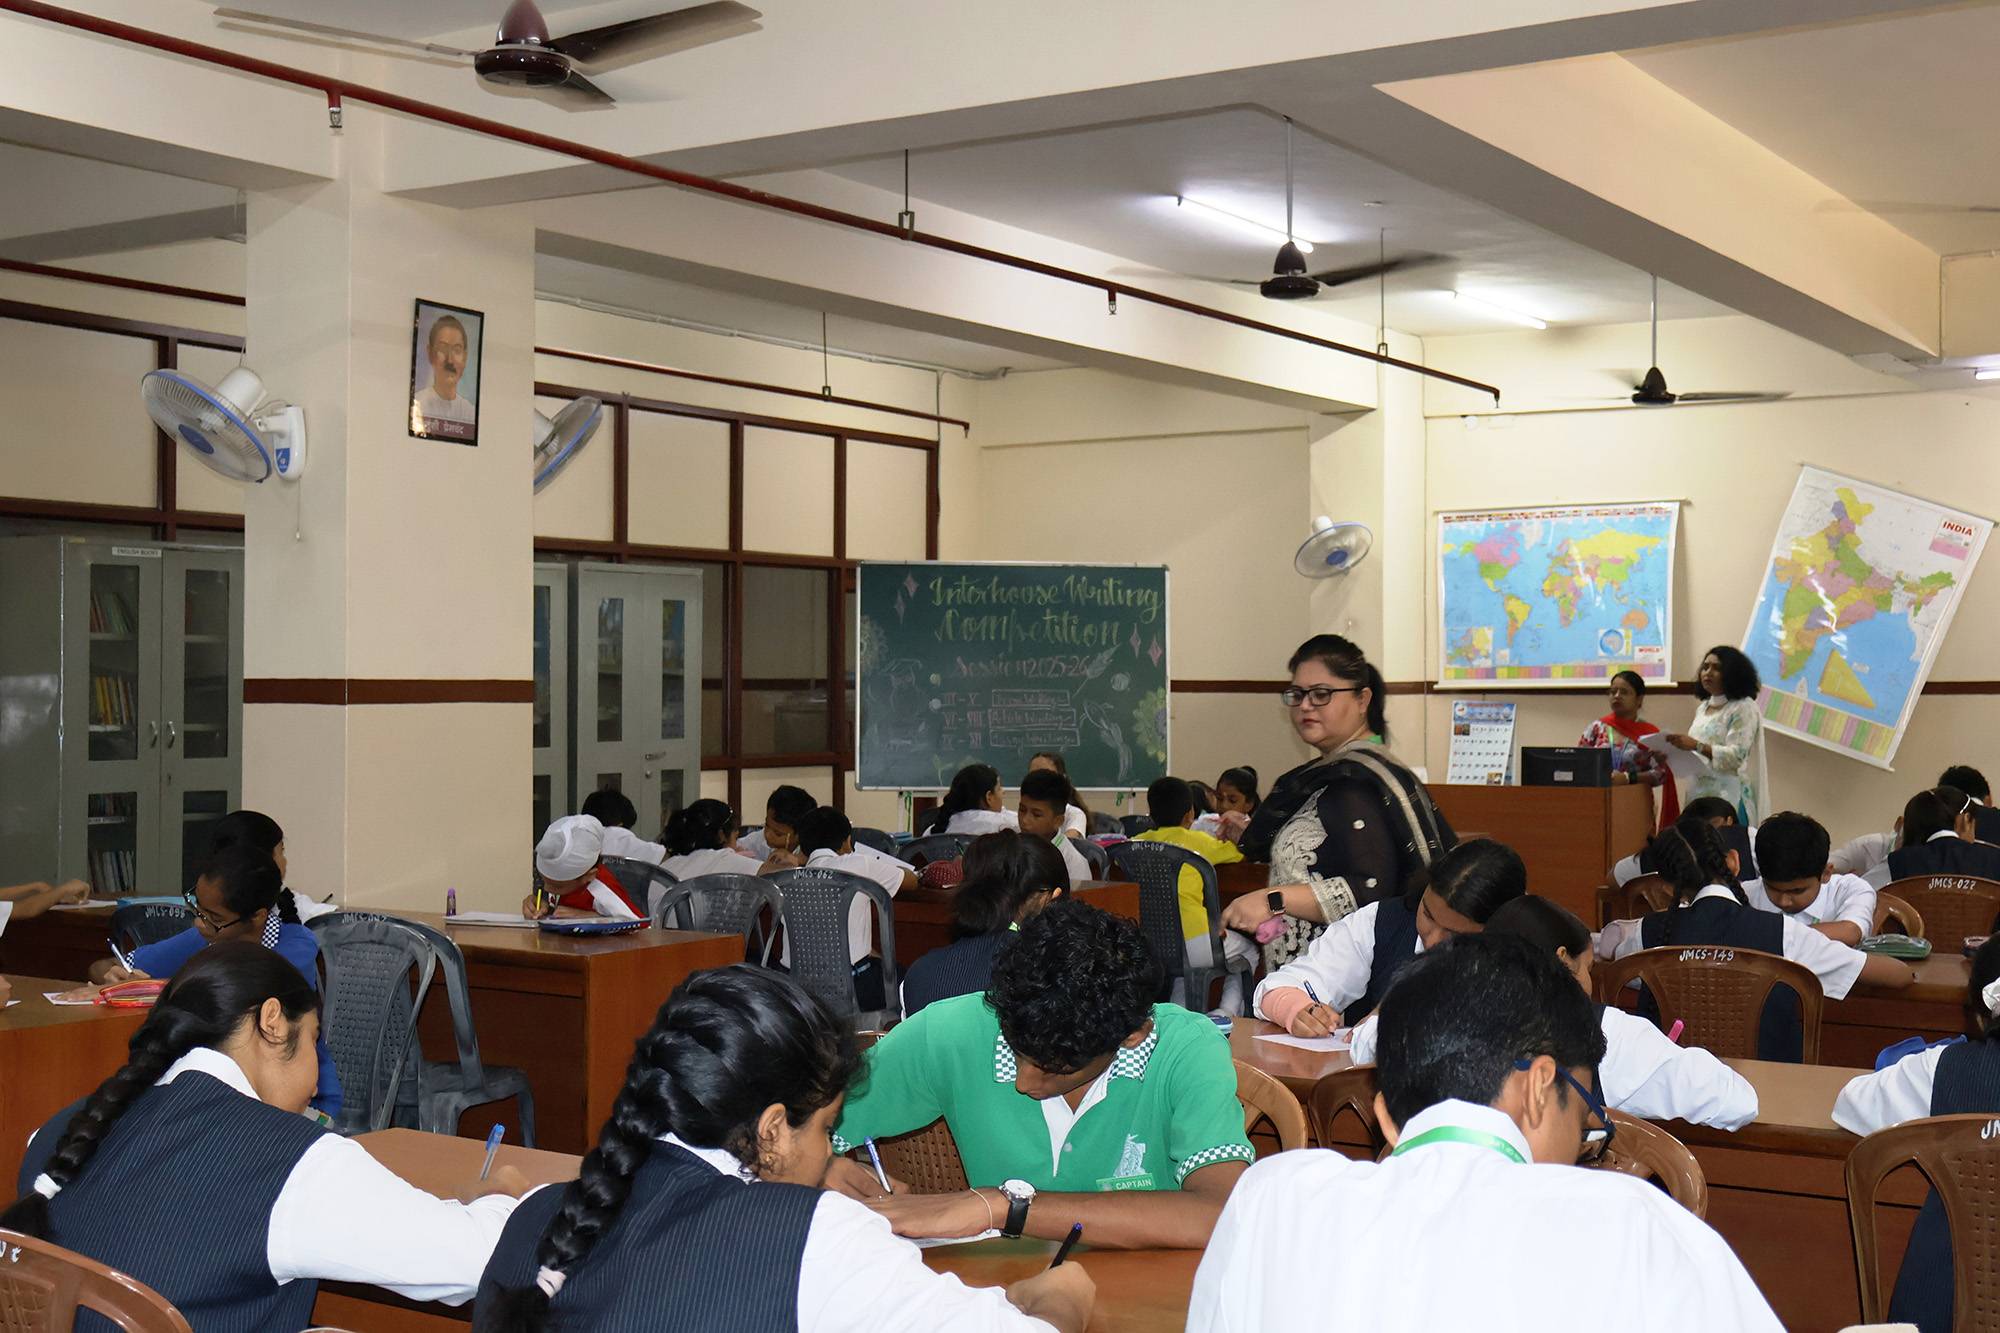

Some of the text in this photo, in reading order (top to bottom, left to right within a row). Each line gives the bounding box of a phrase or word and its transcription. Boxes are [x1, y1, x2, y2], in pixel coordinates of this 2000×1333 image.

[1942, 521, 1972, 536] INDIA
[929, 574, 1163, 625] Interhouse Writing
[934, 608, 1119, 652] Competition
[1115, 1178, 1152, 1190] CAPTAIN
